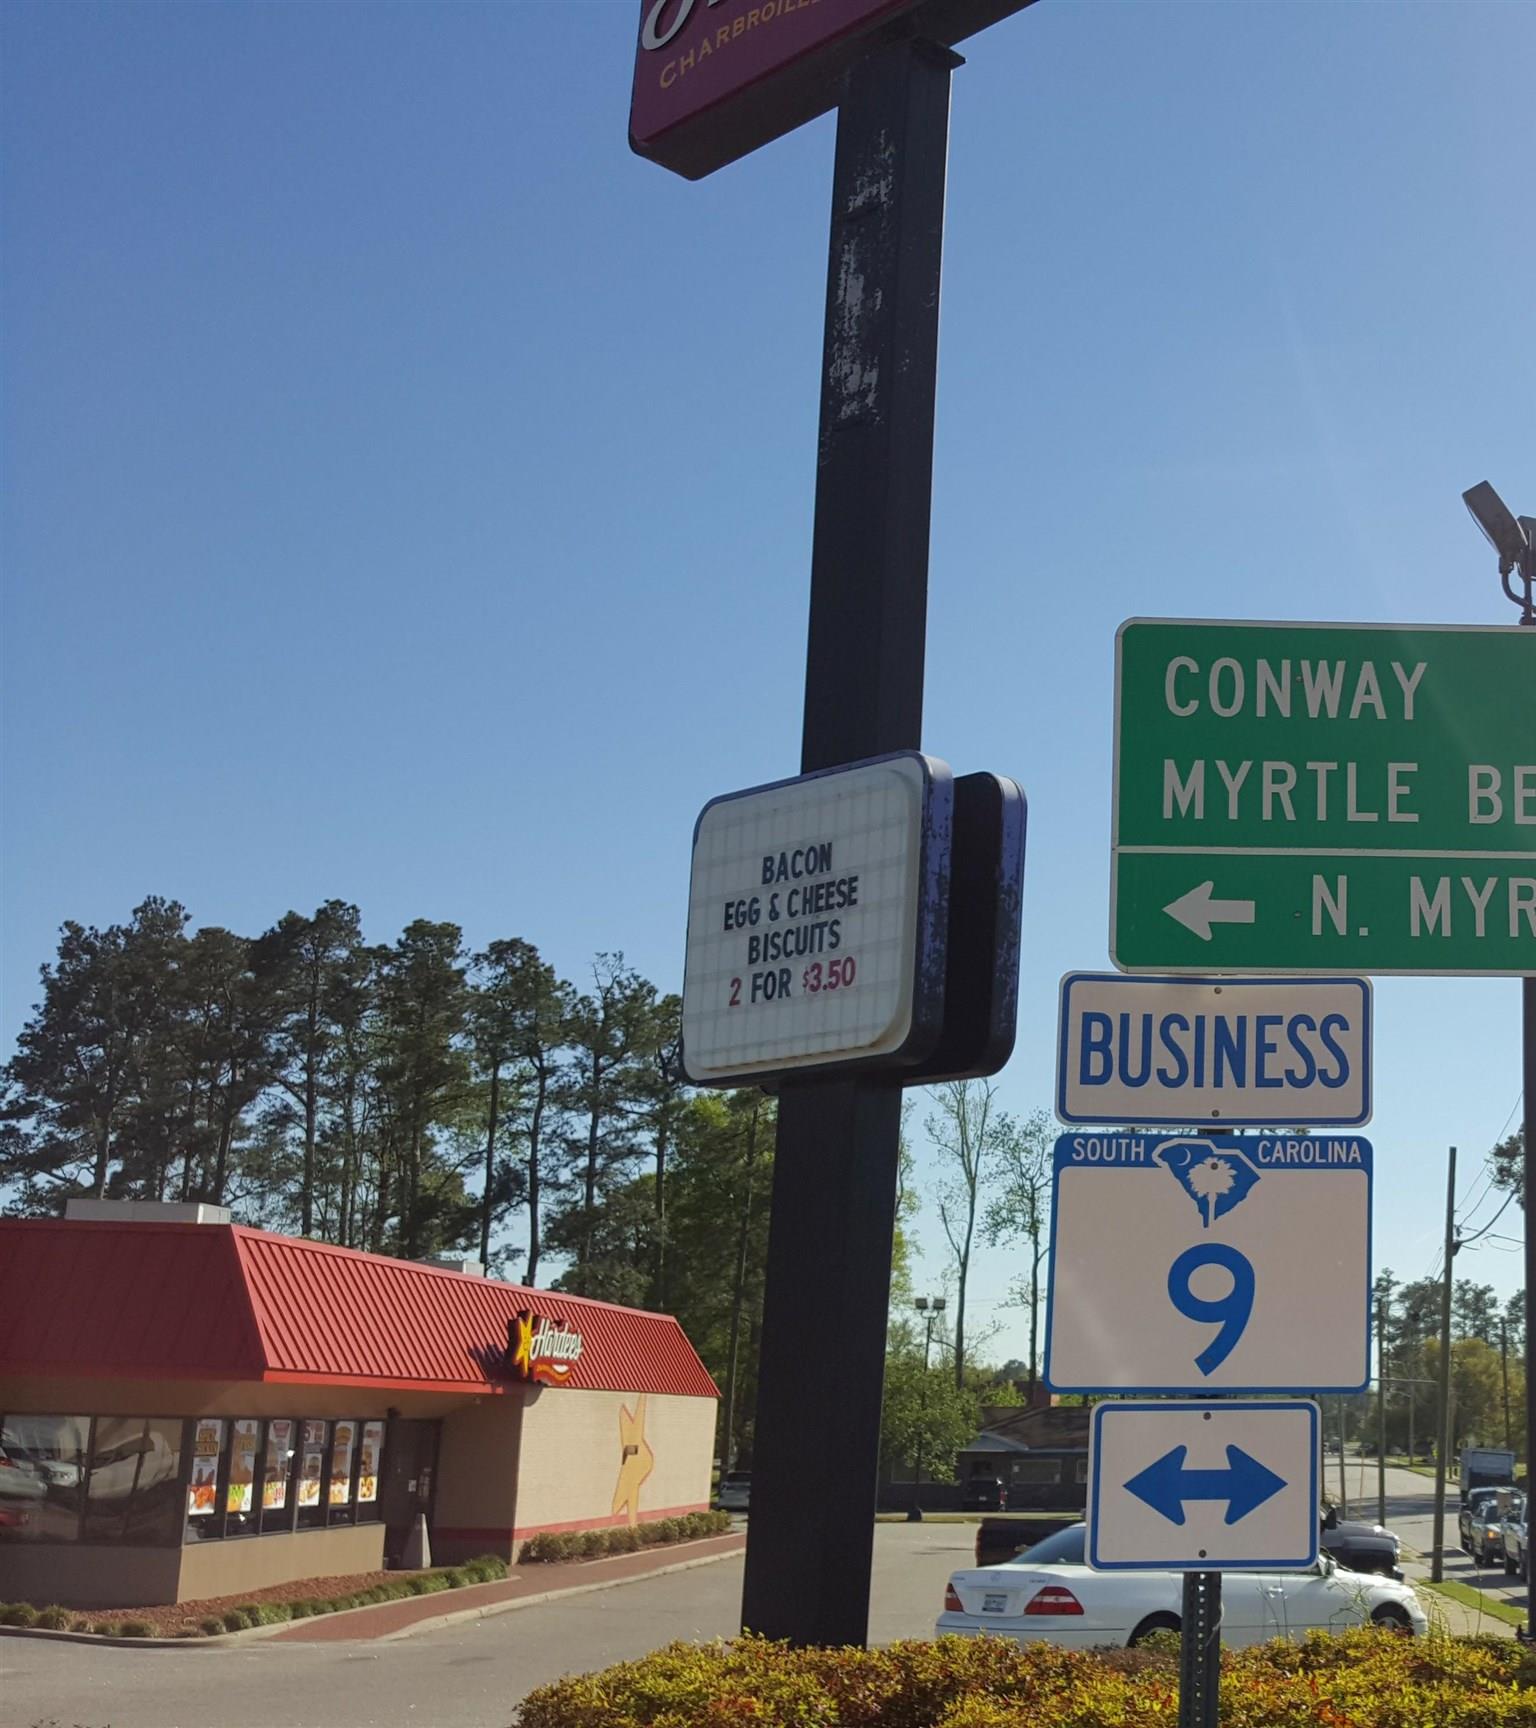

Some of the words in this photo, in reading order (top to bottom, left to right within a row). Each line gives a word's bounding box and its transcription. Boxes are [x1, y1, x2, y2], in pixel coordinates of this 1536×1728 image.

[1165, 656, 1427, 720] CONWAY
[1163, 759, 1419, 822] MYRTLE
[761, 842, 833, 885] BACON
[723, 897, 761, 931] EGG
[768, 892, 780, 922] &
[787, 876, 859, 918] CHEESE
[1312, 875, 1369, 936] N.
[748, 919, 841, 965] BISCUITS
[728, 977, 742, 1007] 2
[750, 967, 792, 1003] FOR
[802, 956, 857, 994] $3.50
[1079, 1011, 1350, 1088] BUSINESS
[1071, 1138, 1145, 1162] SOUTH
[1257, 1140, 1362, 1164] CAROLINA
[1167, 1242, 1256, 1377] 9
